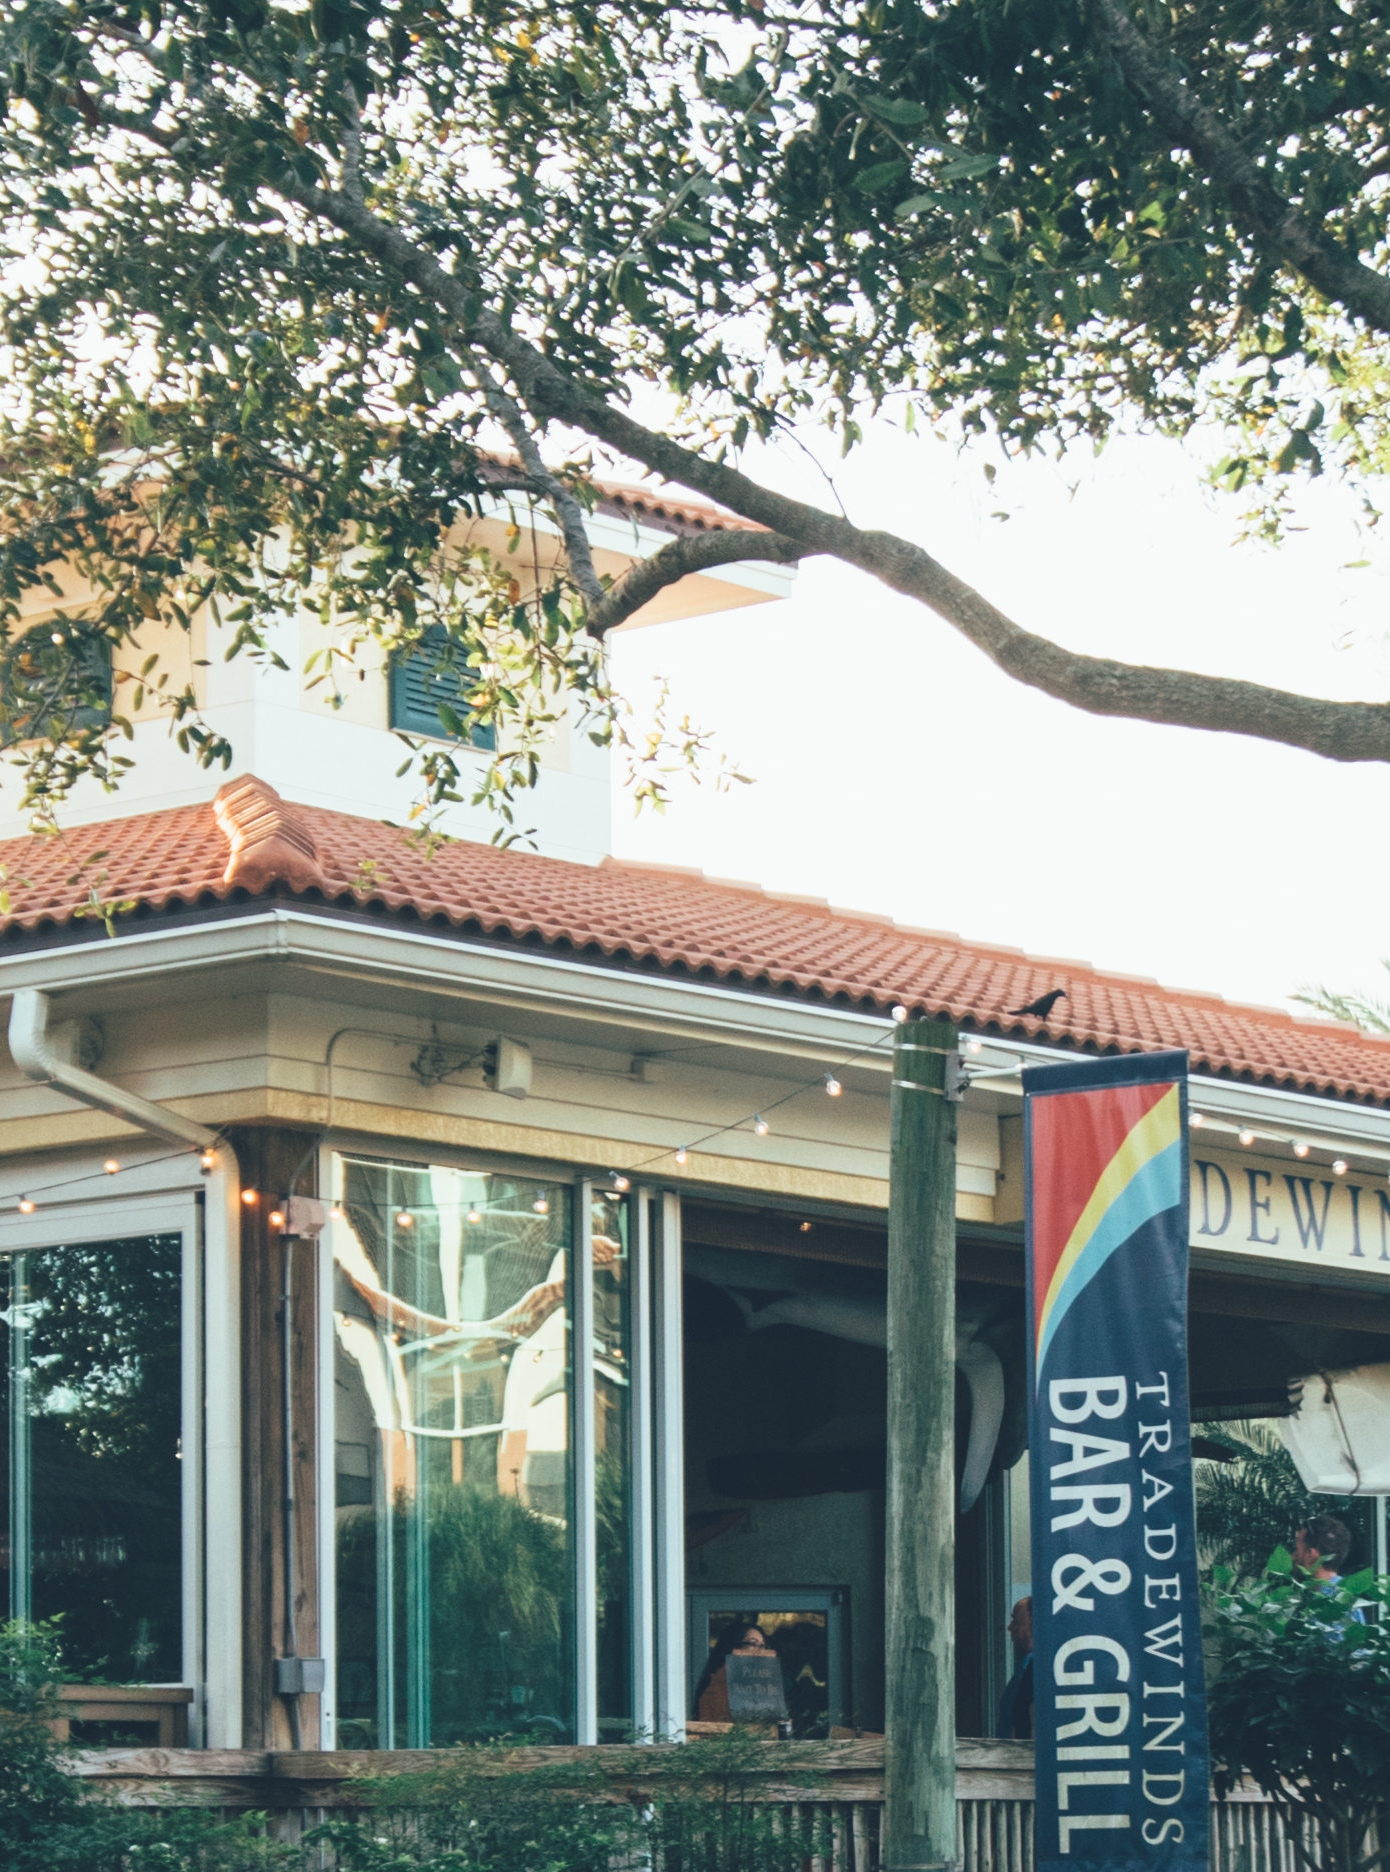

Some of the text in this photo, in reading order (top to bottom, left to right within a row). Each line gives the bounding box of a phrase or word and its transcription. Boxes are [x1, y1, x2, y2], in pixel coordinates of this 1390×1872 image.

[1048, 1374, 1132, 1855] BAR & GRILL
[1135, 1370, 1186, 1846] TRADEWINDS
